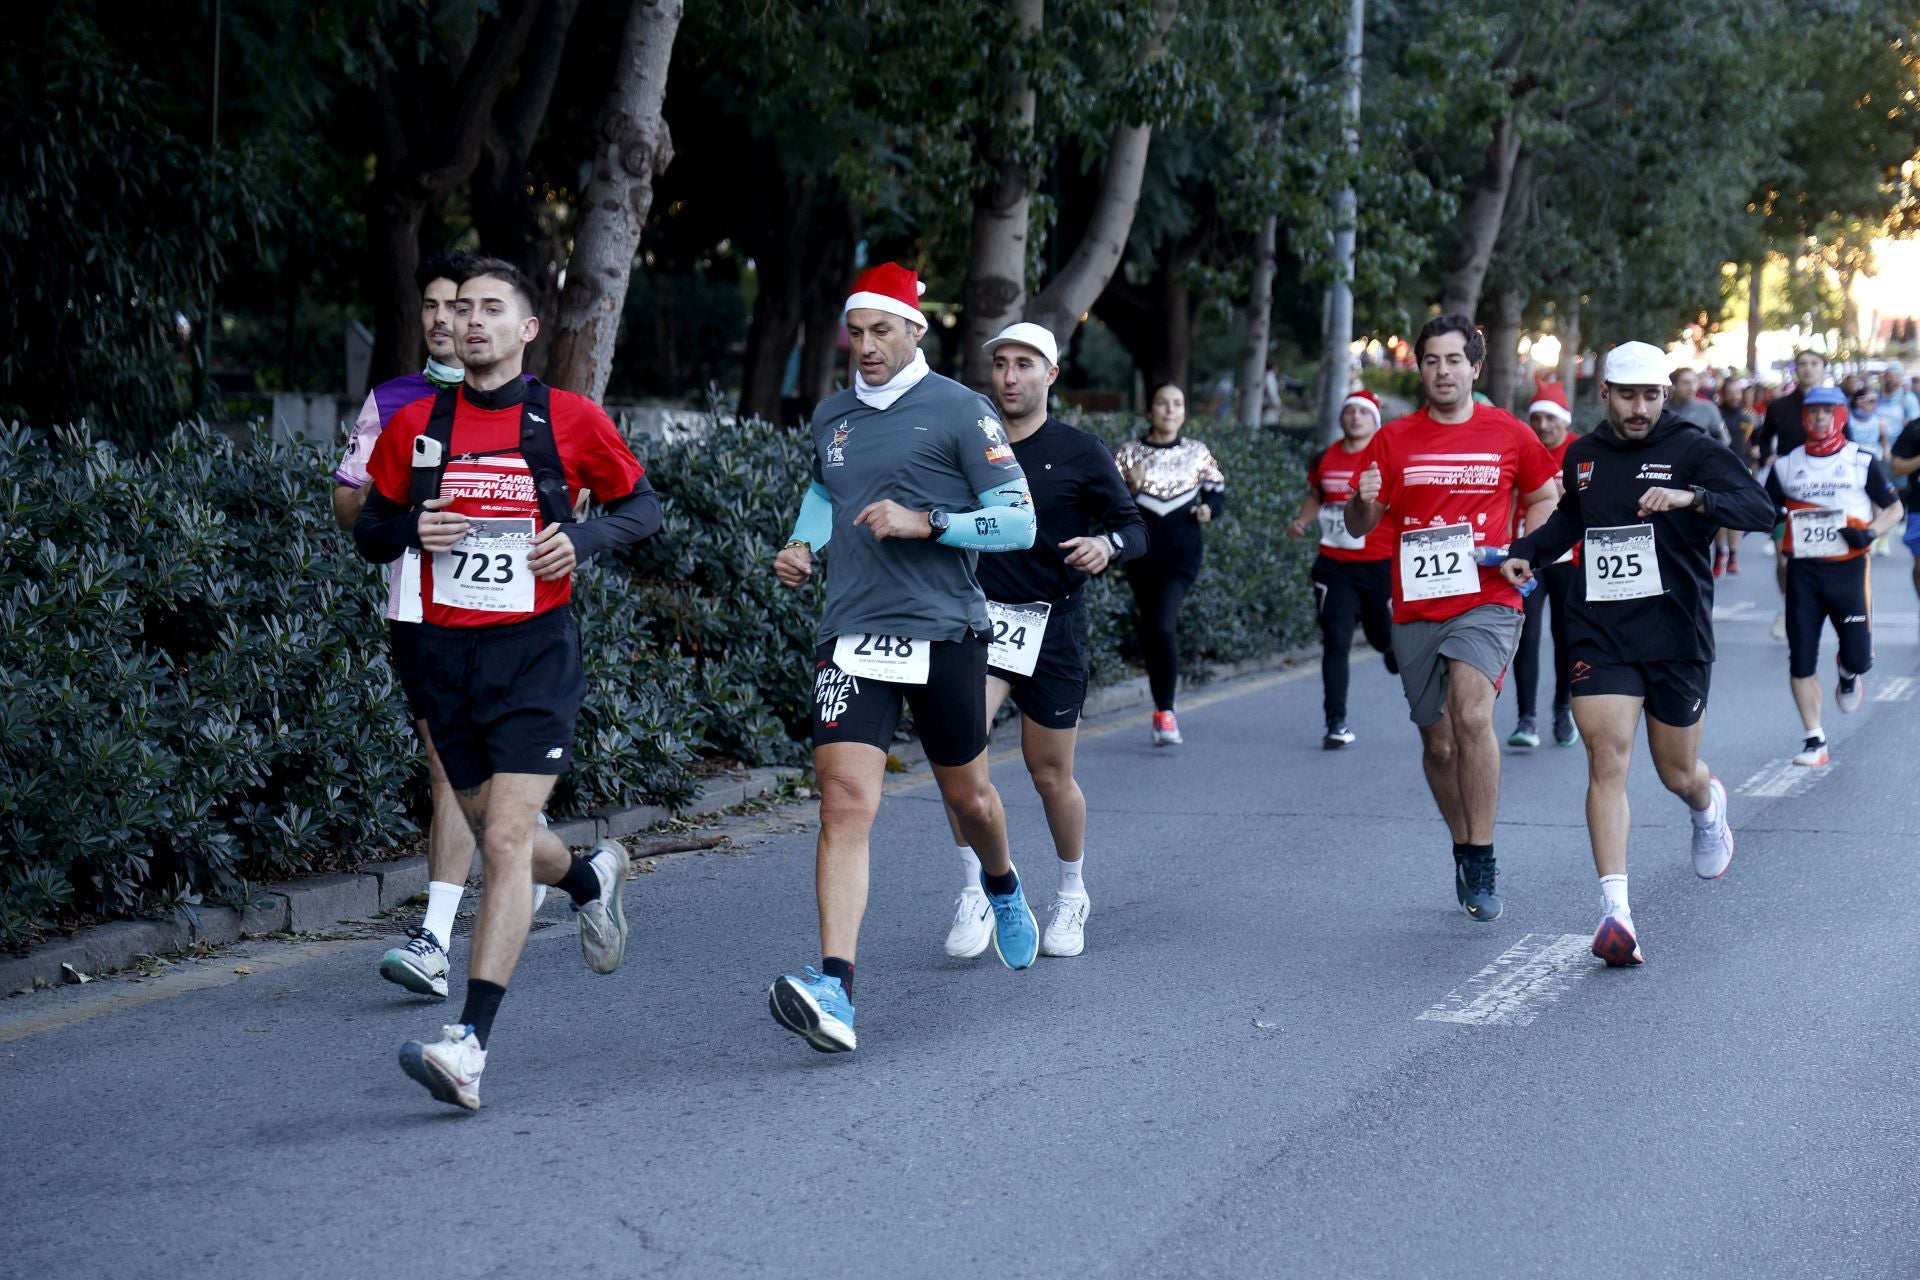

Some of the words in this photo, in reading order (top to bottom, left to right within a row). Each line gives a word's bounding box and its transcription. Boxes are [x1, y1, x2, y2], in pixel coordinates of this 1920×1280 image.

[1463, 465, 1500, 473] CARRERA
[1645, 472, 1673, 481] TERREX
[479, 481, 499, 490] SAN
[500, 483, 535, 493] SILVES
[1428, 477, 1457, 486] PALMA
[1459, 477, 1499, 486] PALMILLA
[450, 487, 489, 498] PALMA
[494, 489, 538, 502] PALMIL
[1803, 526, 1837, 543] 296
[451, 550, 514, 584] 723
[1413, 551, 1462, 579] 212
[1597, 553, 1643, 579] 925
[854, 632, 913, 658] 248
[989, 618, 1026, 650] 24
[816, 684, 851, 706] GIVE
[821, 700, 848, 723] UP
